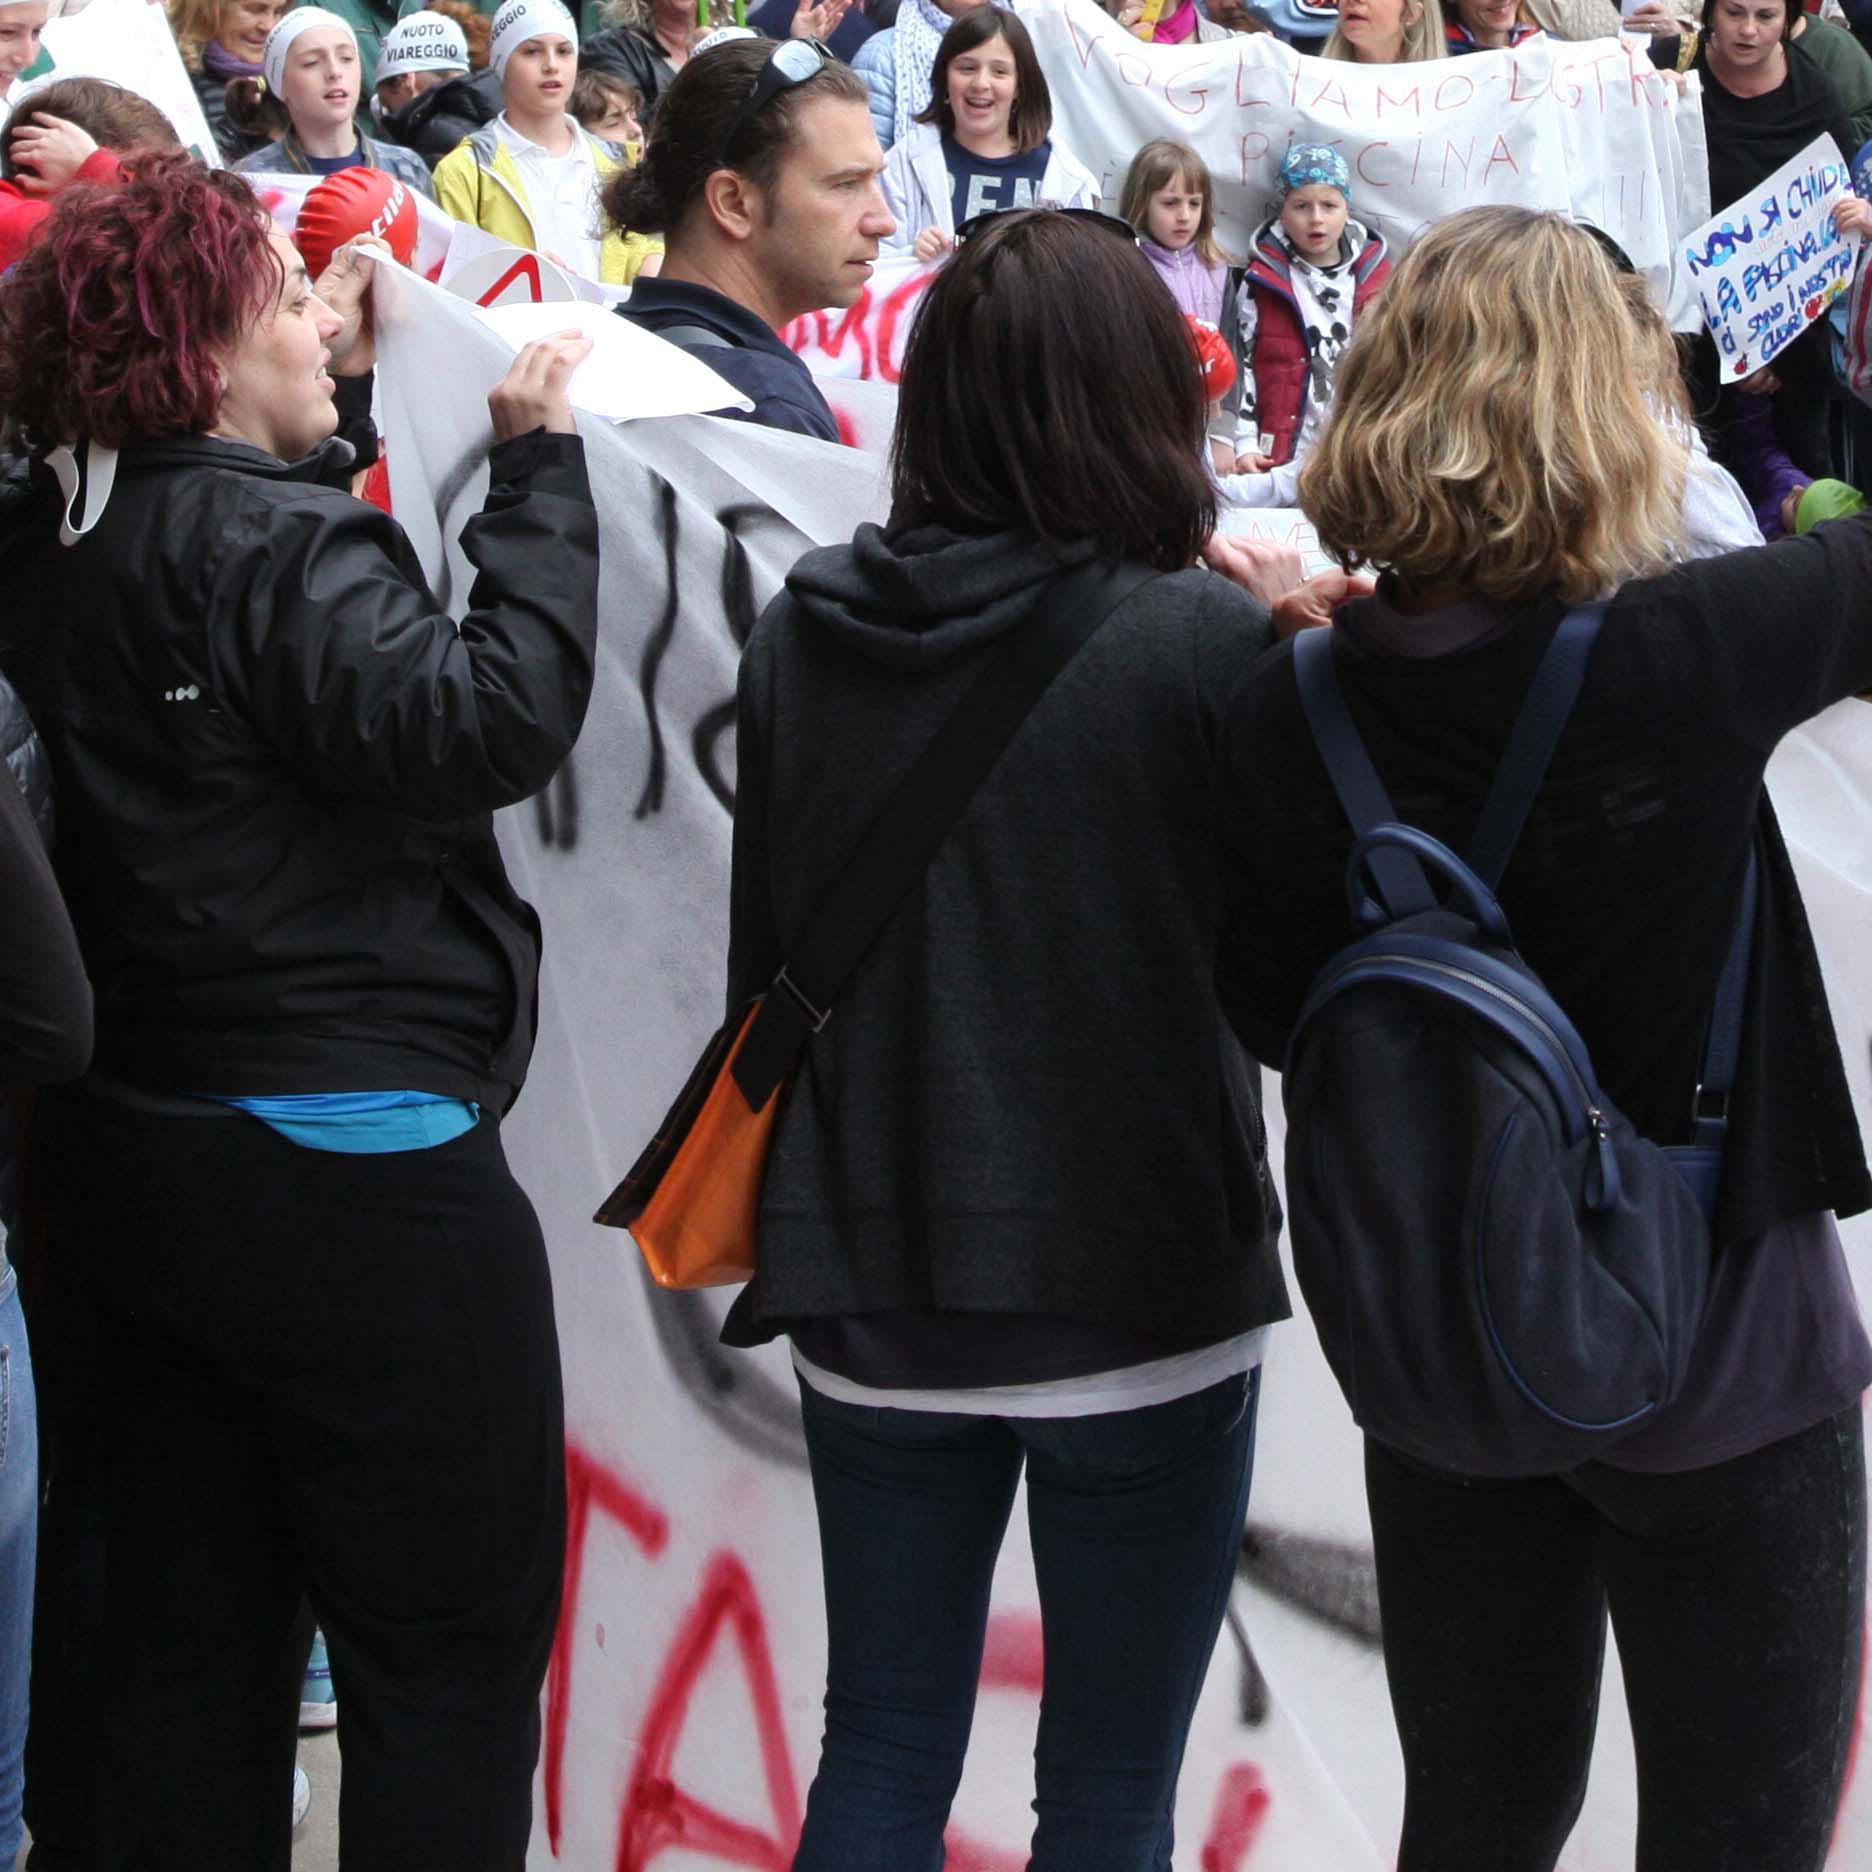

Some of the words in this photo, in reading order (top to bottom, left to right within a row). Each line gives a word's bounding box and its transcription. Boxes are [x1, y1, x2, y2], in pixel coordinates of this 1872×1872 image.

[385, 43, 460, 63] VIAREGGIO
[399, 23, 446, 40] NUOTO
[1065, 2, 1475, 116] VOGLIAMO
[1685, 214, 1754, 276] NON
[1700, 276, 1742, 331] LA
